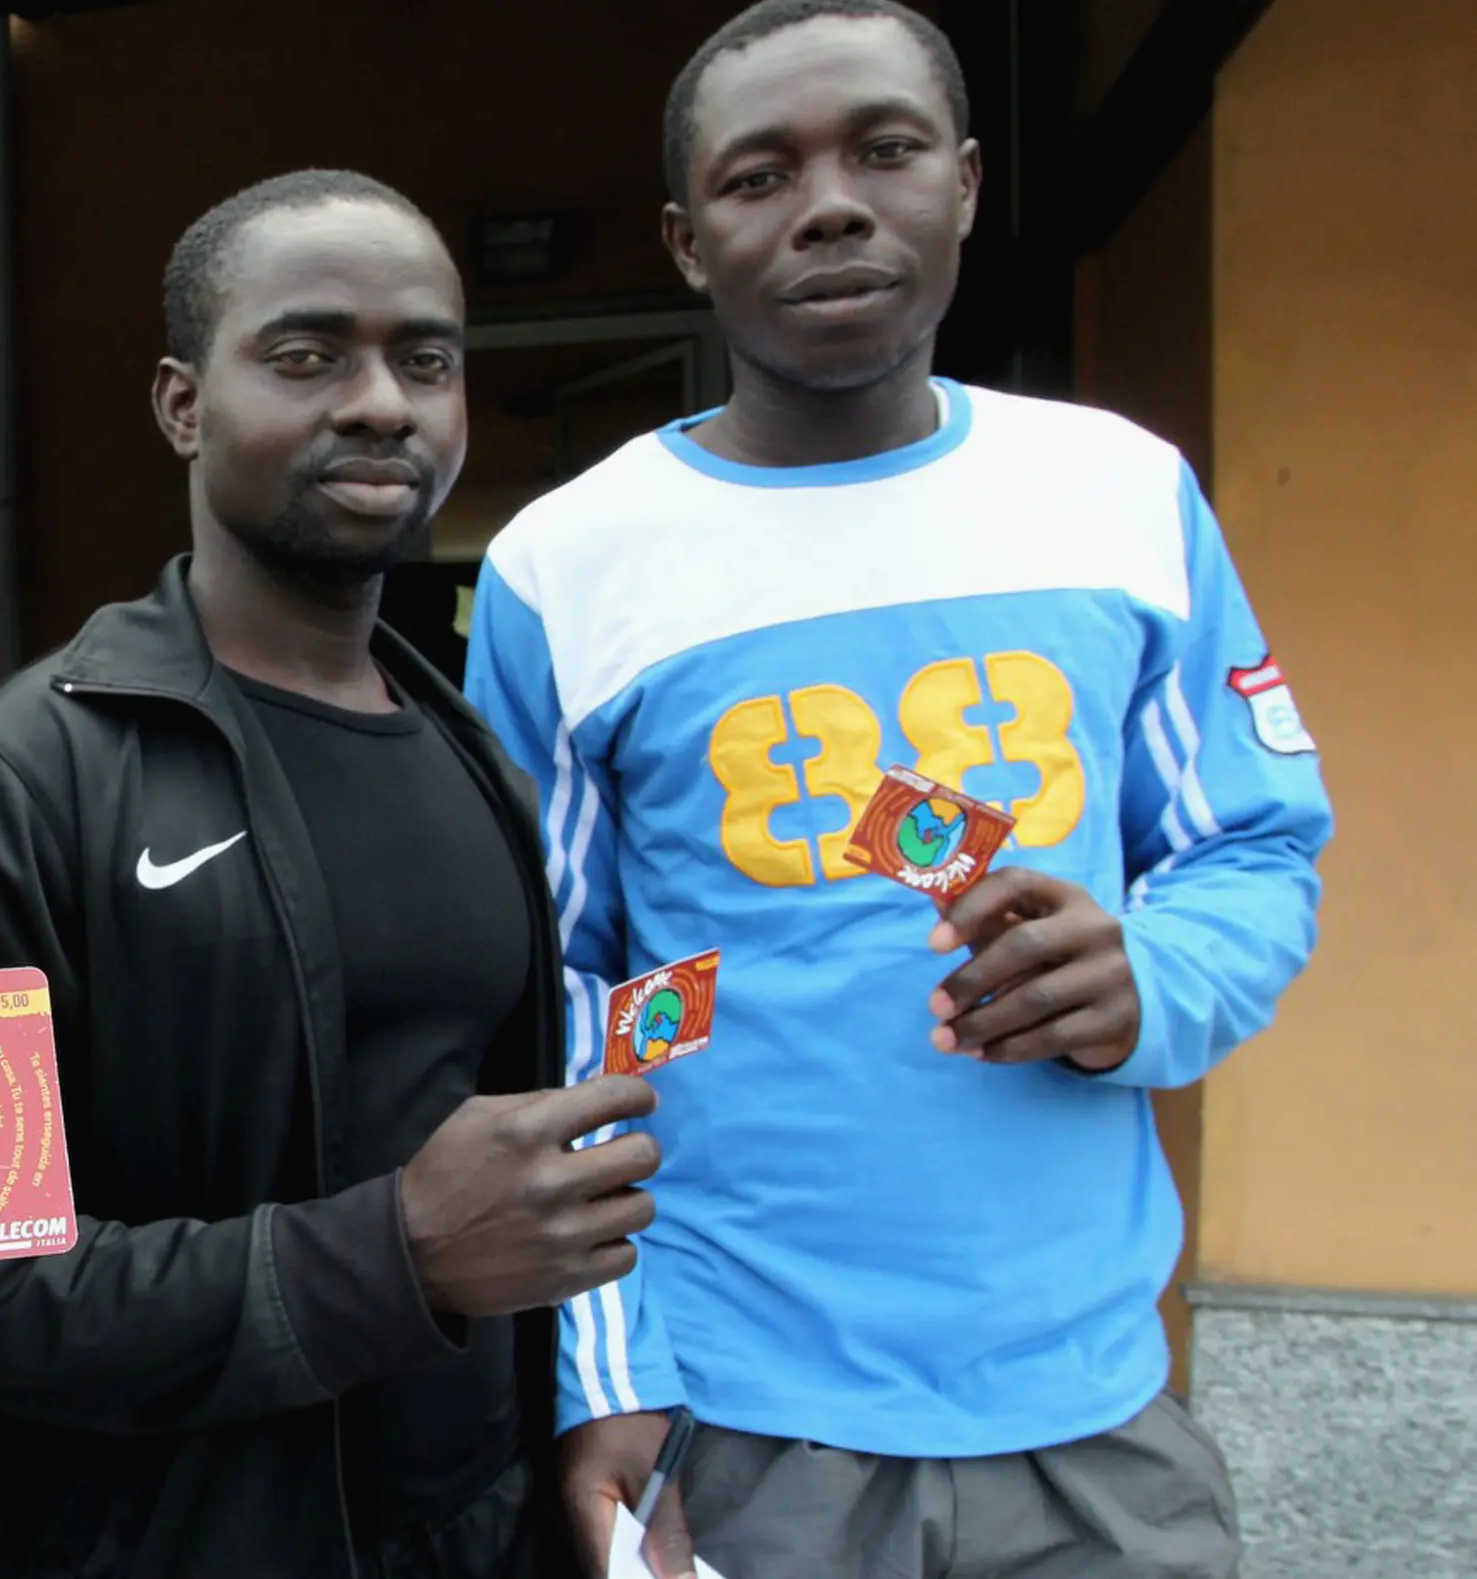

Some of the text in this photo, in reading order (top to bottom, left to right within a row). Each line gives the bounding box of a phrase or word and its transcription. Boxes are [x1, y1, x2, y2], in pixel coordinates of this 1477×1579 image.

[708, 650, 1086, 887] 88
[29, 1051, 41, 1068] Te
[10, 1085, 23, 1101] Tu
[14, 1101, 24, 1115] te
[14, 1116, 25, 1143] sens
[37, 1111, 53, 1172] enseguida
[13, 1144, 25, 1169] tout
[6, 1170, 19, 1186] de
[31, 1171, 43, 1187] en
[35, 1238, 68, 1248] ITALIA
